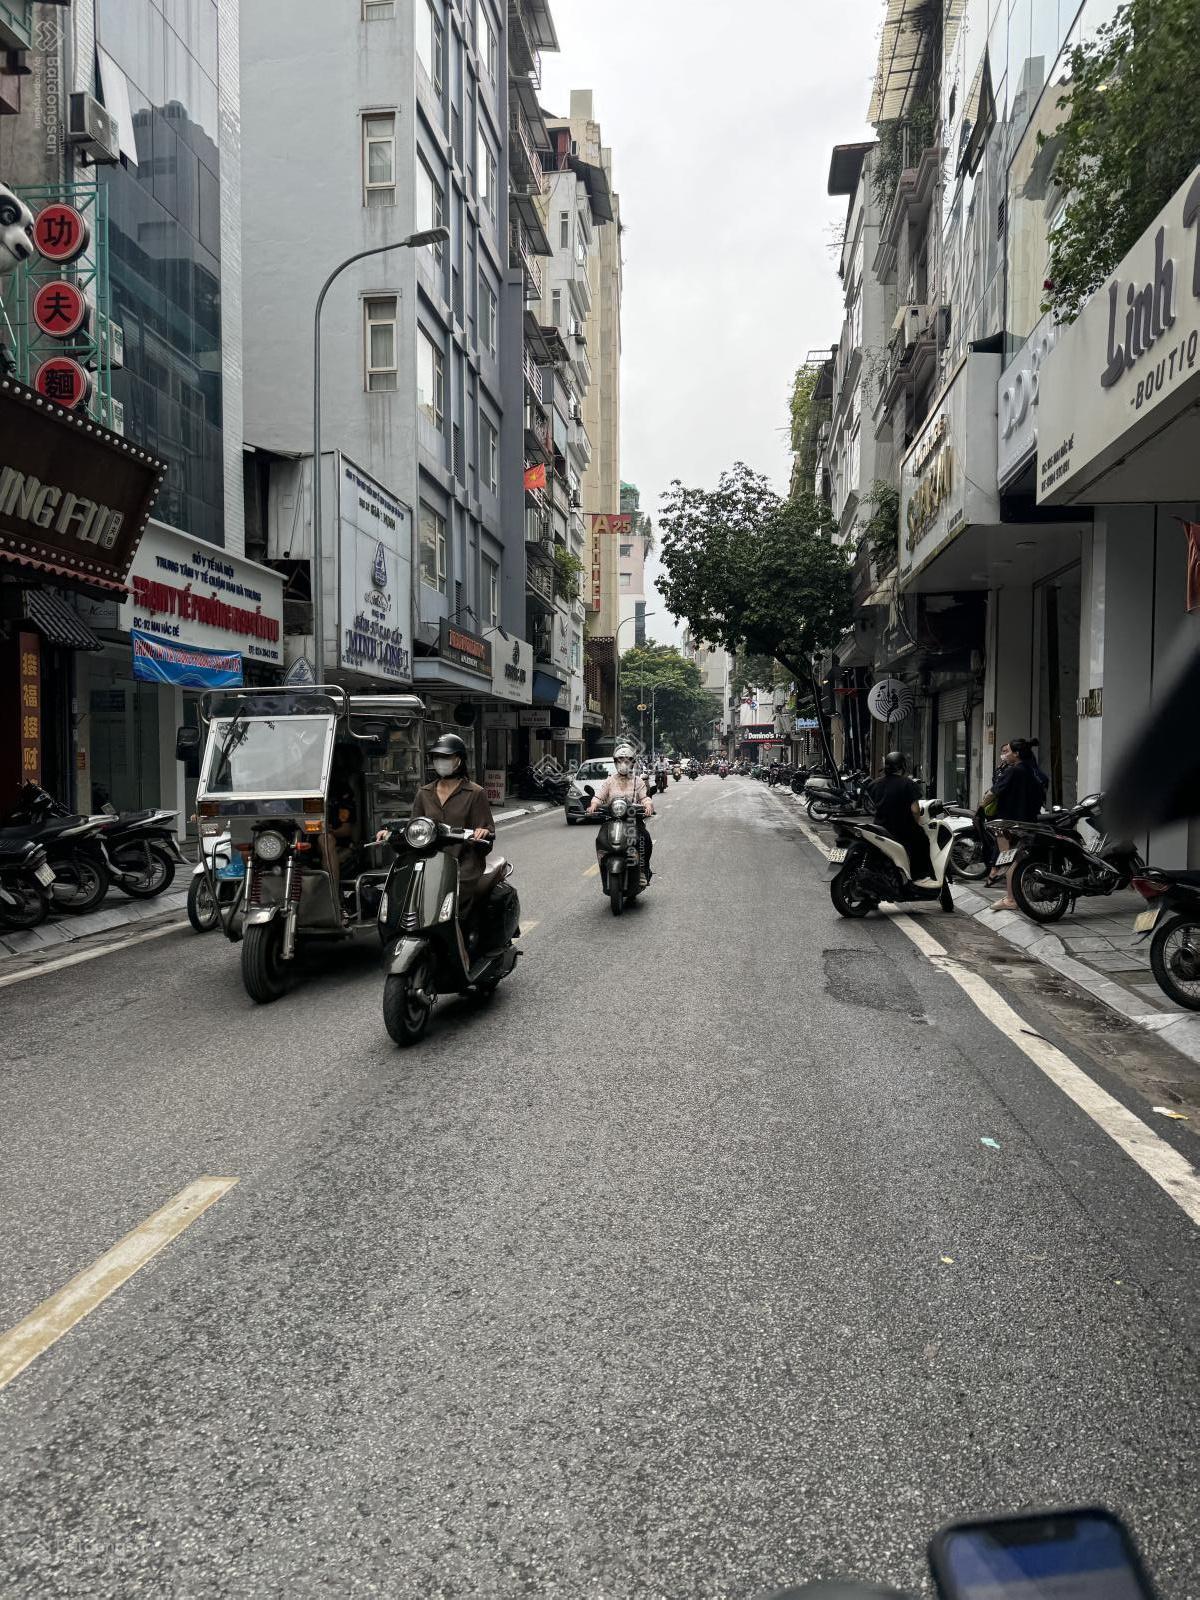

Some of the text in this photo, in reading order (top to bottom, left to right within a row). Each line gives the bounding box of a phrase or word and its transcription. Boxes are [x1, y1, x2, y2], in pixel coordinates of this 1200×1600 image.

[1101, 226, 1176, 388] Linh
[155, 555, 180, 574] TRUNG
[748, 732, 774, 740] Domino's
